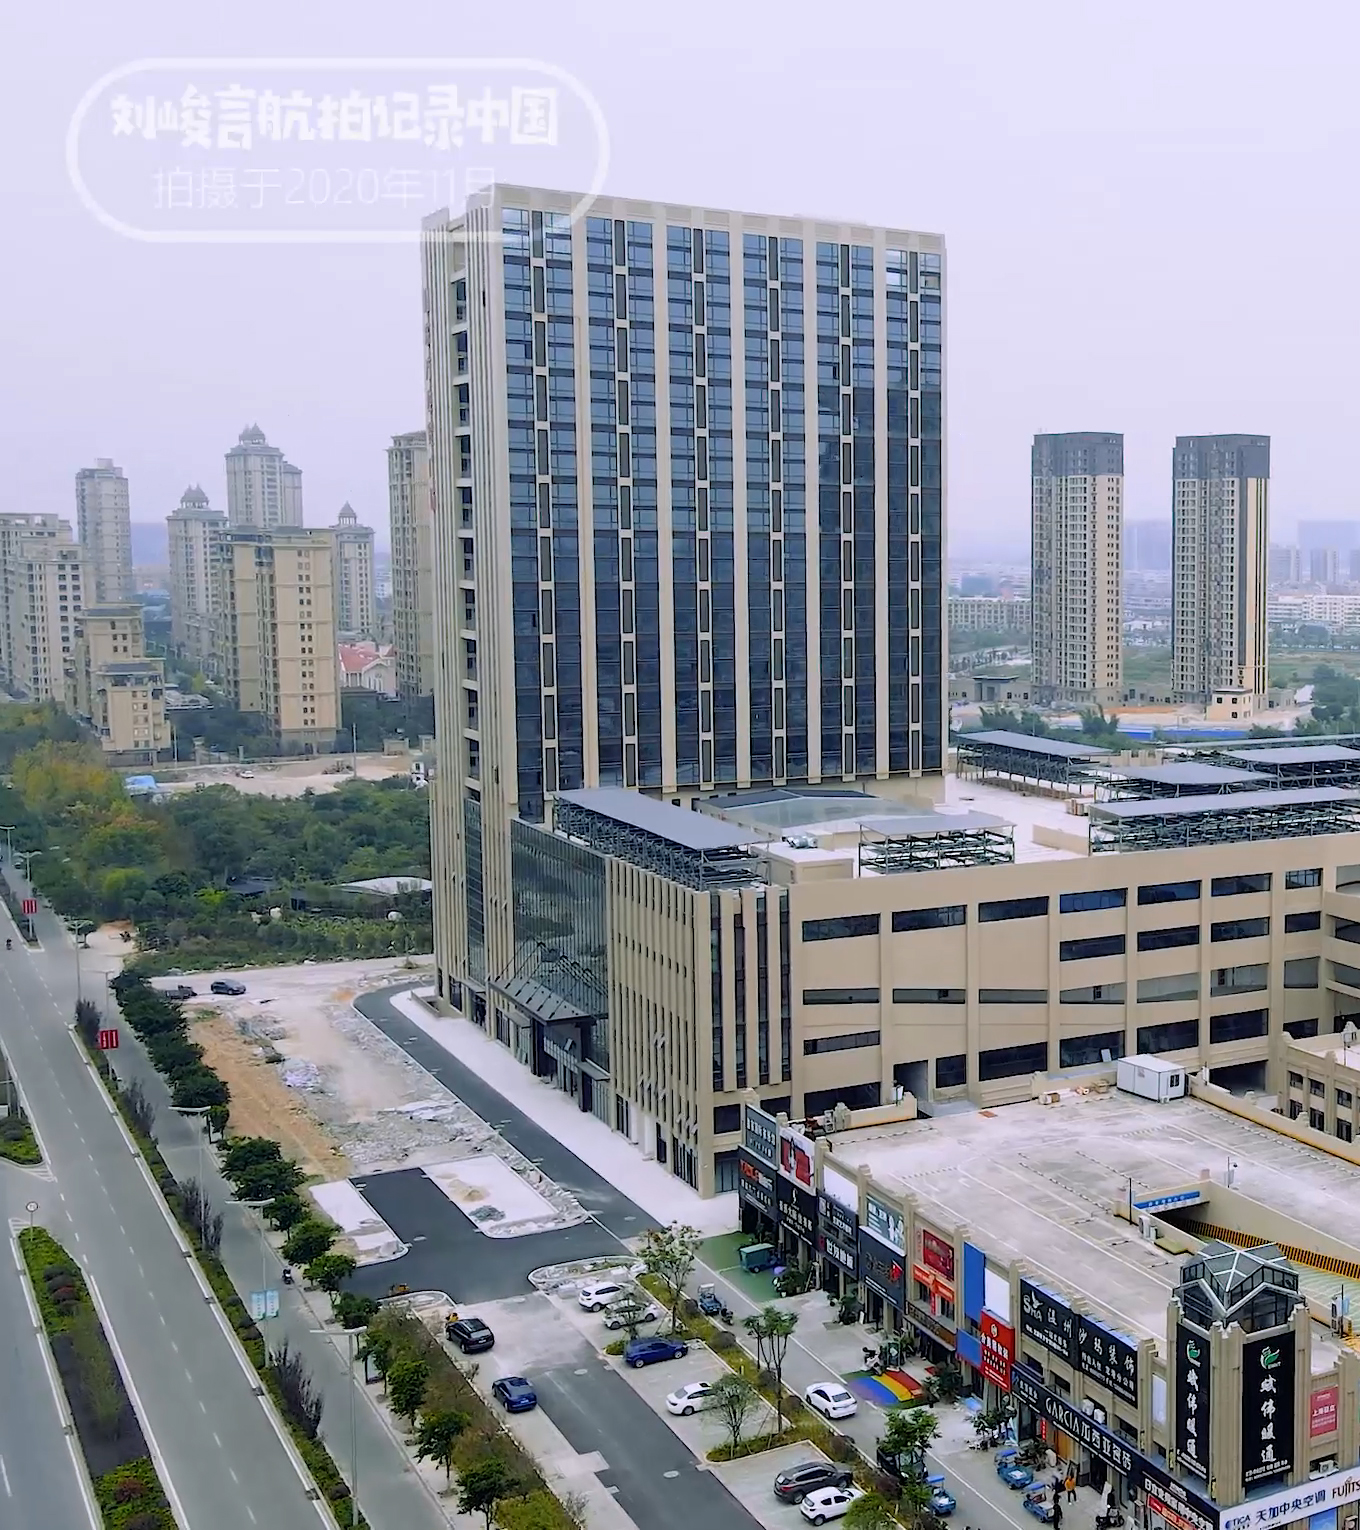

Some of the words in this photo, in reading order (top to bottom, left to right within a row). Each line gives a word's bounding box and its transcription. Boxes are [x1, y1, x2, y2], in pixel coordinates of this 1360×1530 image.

[1045, 1397, 1080, 1435] GARCIA
[1255, 1489, 1326, 1525] 天加中央空调
